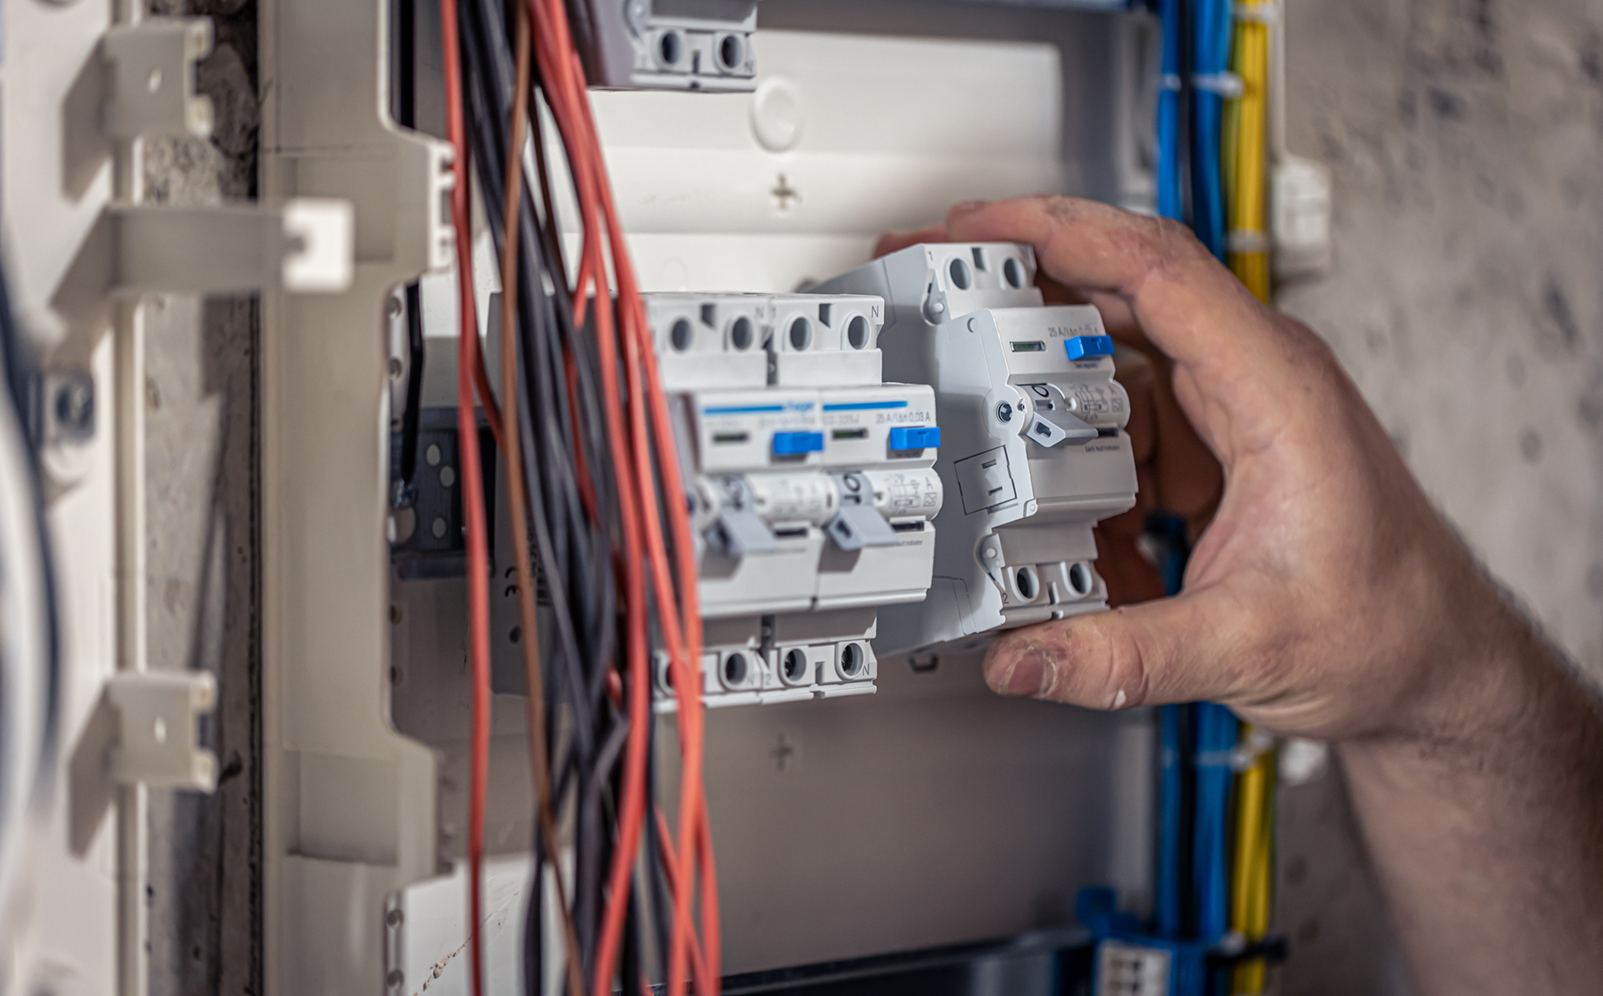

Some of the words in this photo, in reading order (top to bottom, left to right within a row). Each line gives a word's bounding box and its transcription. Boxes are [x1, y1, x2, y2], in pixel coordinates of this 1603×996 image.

[871, 305, 880, 318] N
[1002, 593, 1010, 605] 2
[862, 663, 871, 676] N
[764, 674, 772, 686] 2
